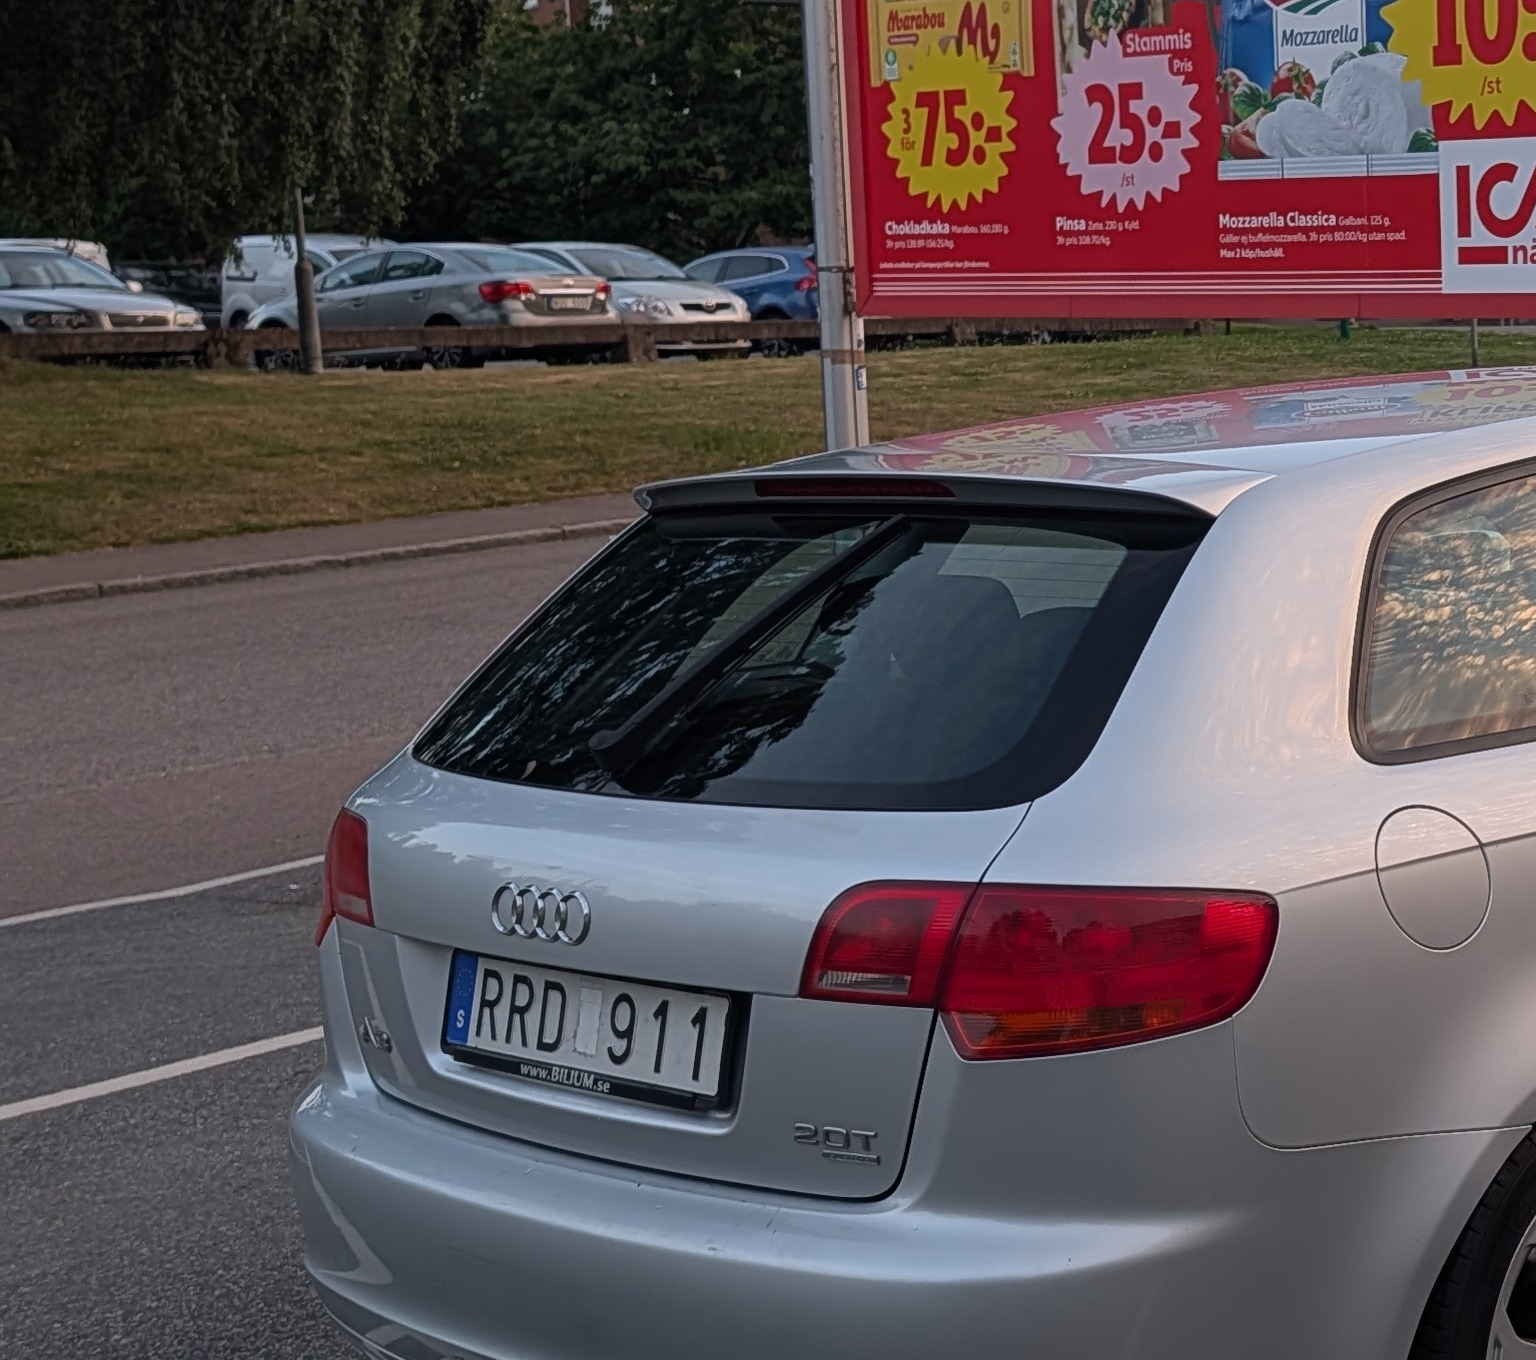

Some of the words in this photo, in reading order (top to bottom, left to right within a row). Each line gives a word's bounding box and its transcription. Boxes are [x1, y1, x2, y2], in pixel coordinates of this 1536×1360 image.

[887, 6, 945, 33] Marabou
[1125, 28, 1192, 53] Stammis
[1281, 24, 1359, 48] Mozzarella
[1173, 58, 1193, 72] Pris
[1480, 76, 1502, 96] /st
[901, 107, 912, 135] 3
[900, 137, 915, 152] för
[1120, 171, 1135, 188] /st
[885, 220, 950, 235] Chokladkaka
[1055, 216, 1086, 231] Pinsa
[1218, 210, 1285, 228] Mozzarella
[1286, 209, 1336, 227] Classica
[456, 1008, 464, 1028] S
[475, 967, 567, 1053] RRD
[607, 992, 708, 1082] 911
[520, 1064, 610, 1093] www.BILIUM.se
